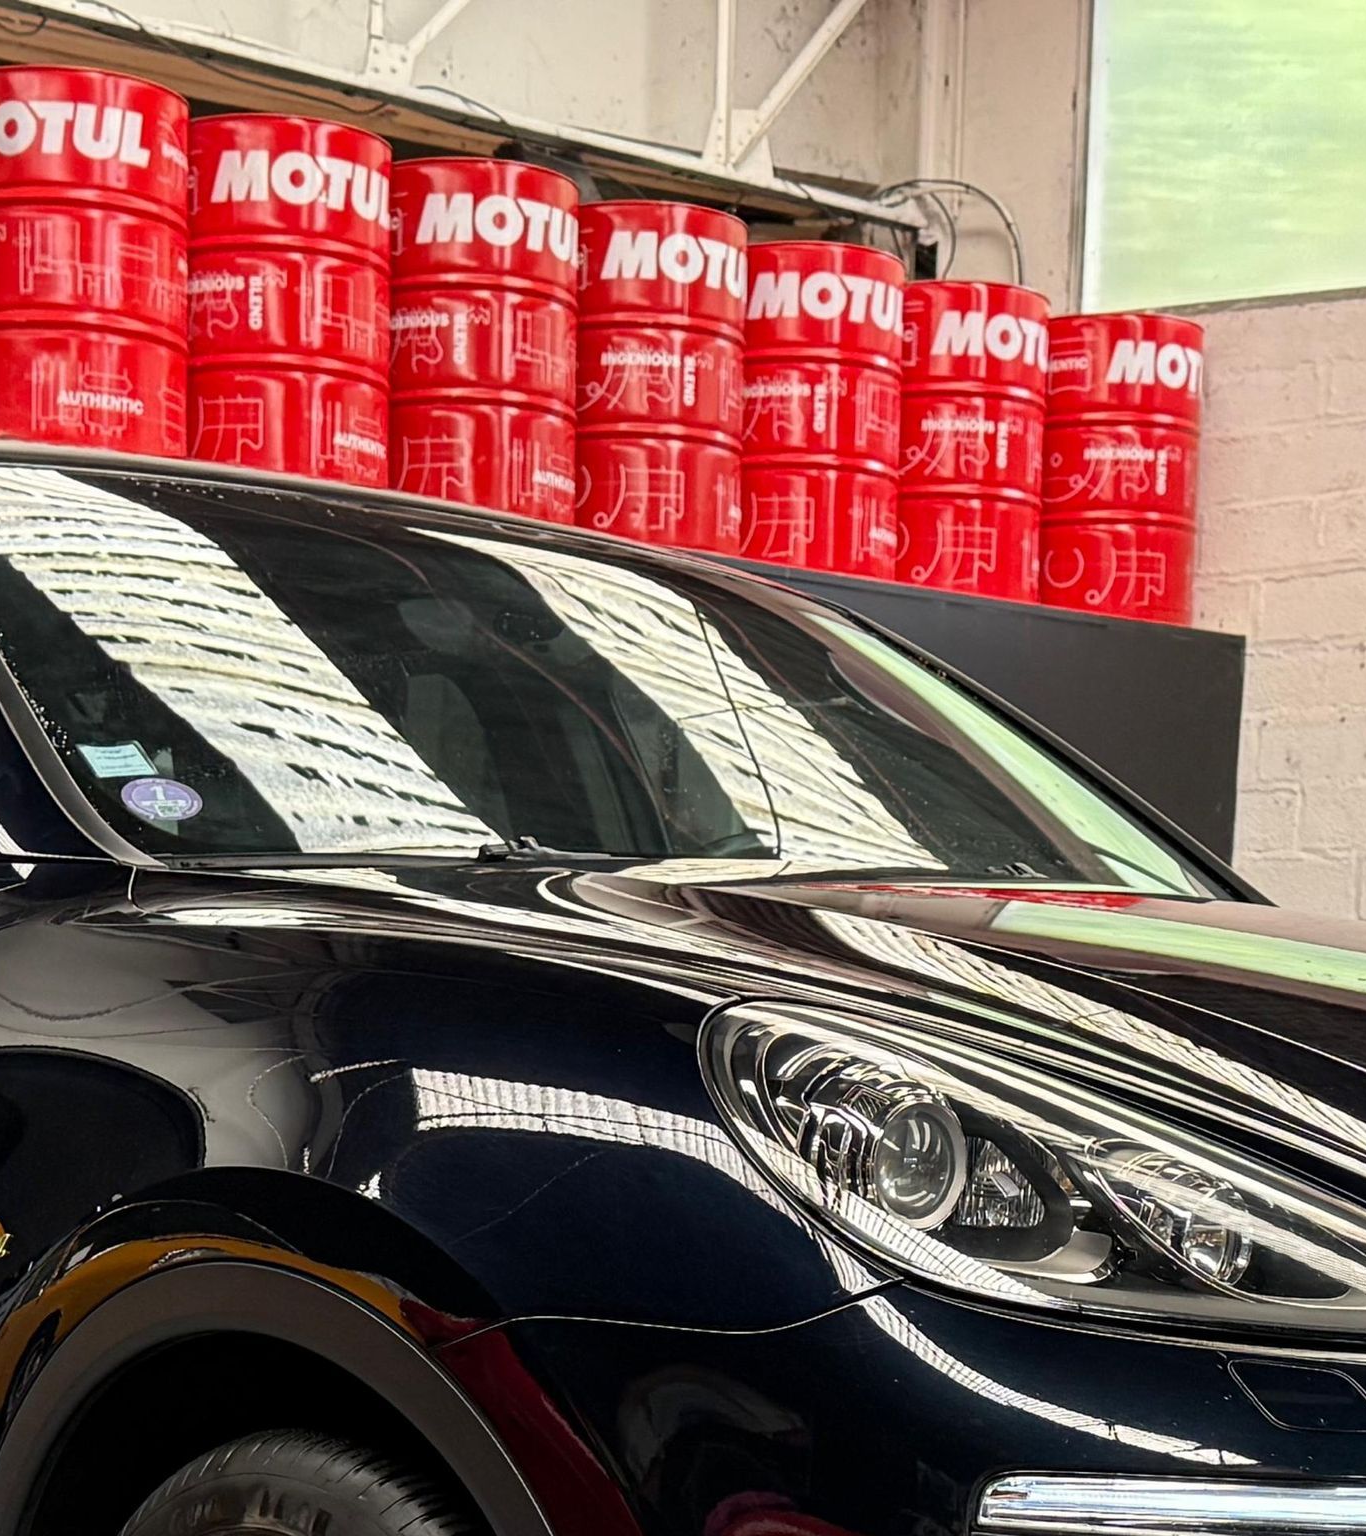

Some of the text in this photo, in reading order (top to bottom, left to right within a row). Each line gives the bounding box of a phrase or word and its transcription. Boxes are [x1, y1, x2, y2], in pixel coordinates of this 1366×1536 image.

[248, 276, 263, 331] BLEND
[453, 313, 467, 365] BLEND
[56, 388, 144, 416] AUTHENTIC
[600, 351, 696, 406] INGENIOUS BLEND
[813, 384, 827, 434] BLEND
